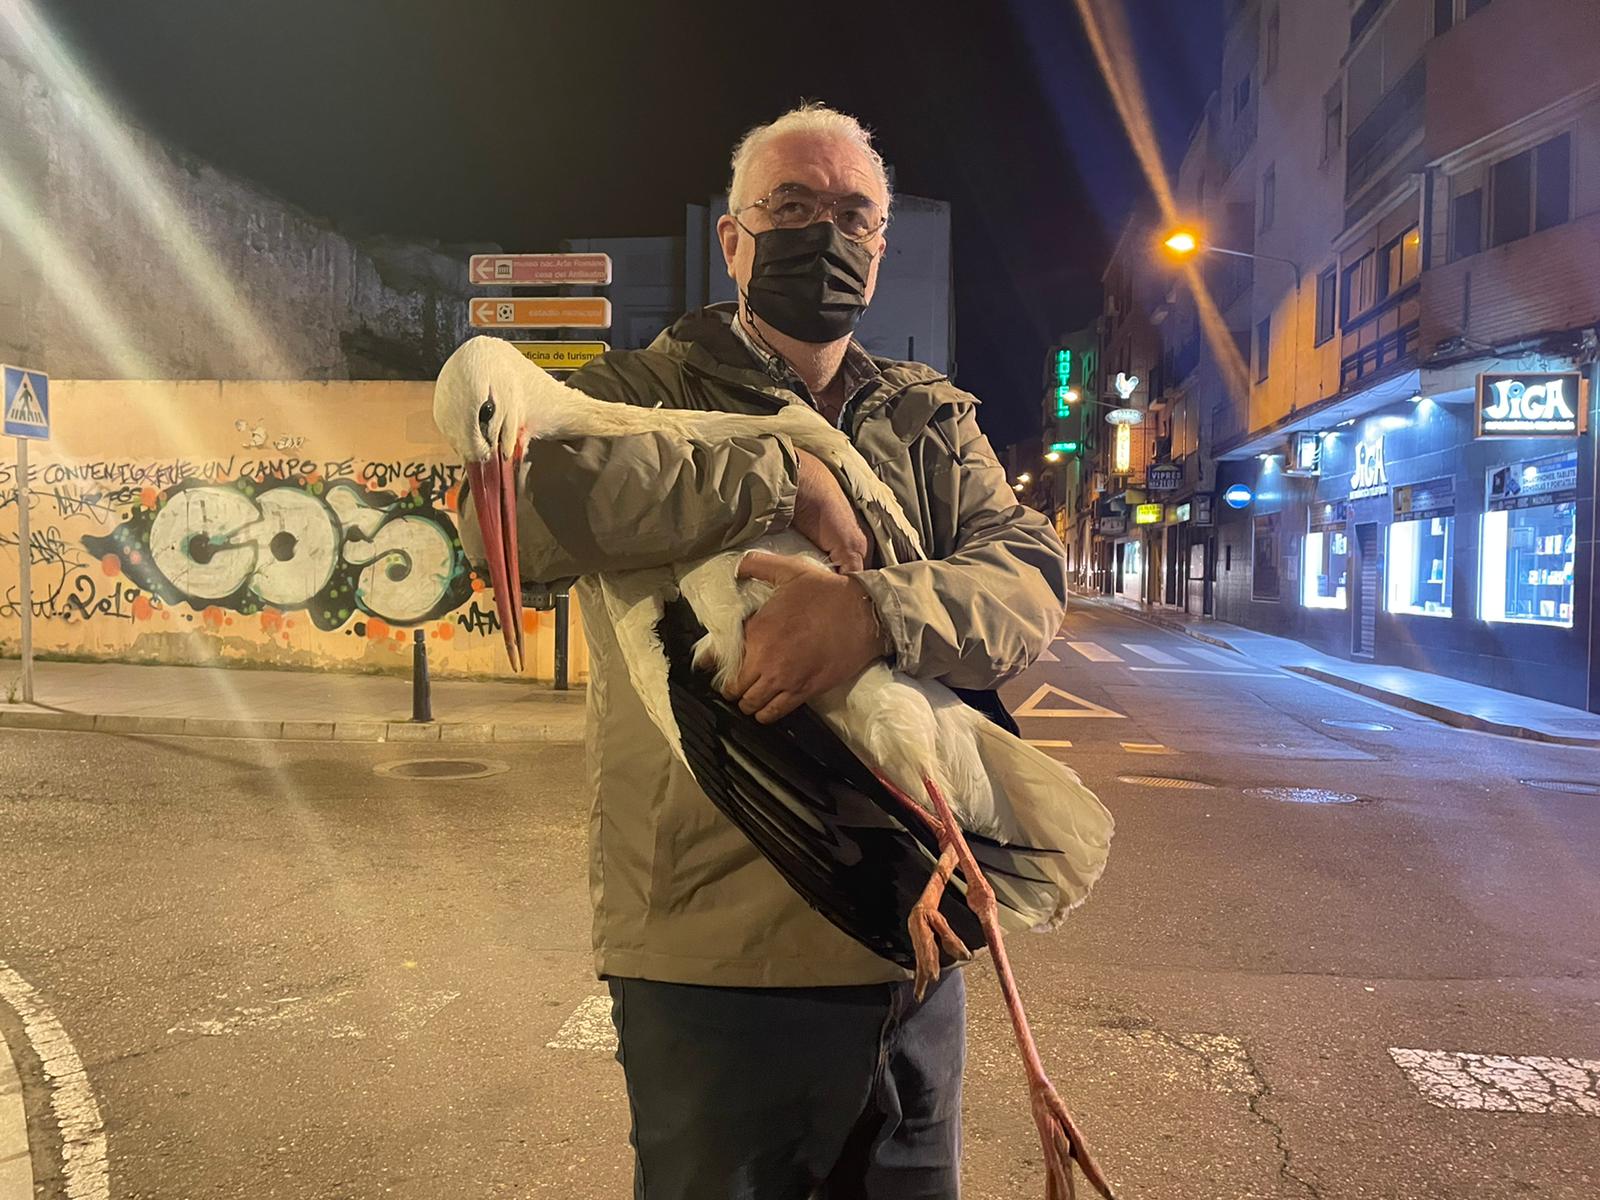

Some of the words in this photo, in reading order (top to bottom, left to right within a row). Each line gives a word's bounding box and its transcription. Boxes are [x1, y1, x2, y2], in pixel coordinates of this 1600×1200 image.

[553, 352, 565, 360] de
[567, 351, 597, 360] turism
[1059, 349, 1070, 410] HOTEL
[203, 455, 234, 478] UN
[240, 457, 317, 480] CAMPO
[324, 457, 355, 480] DE
